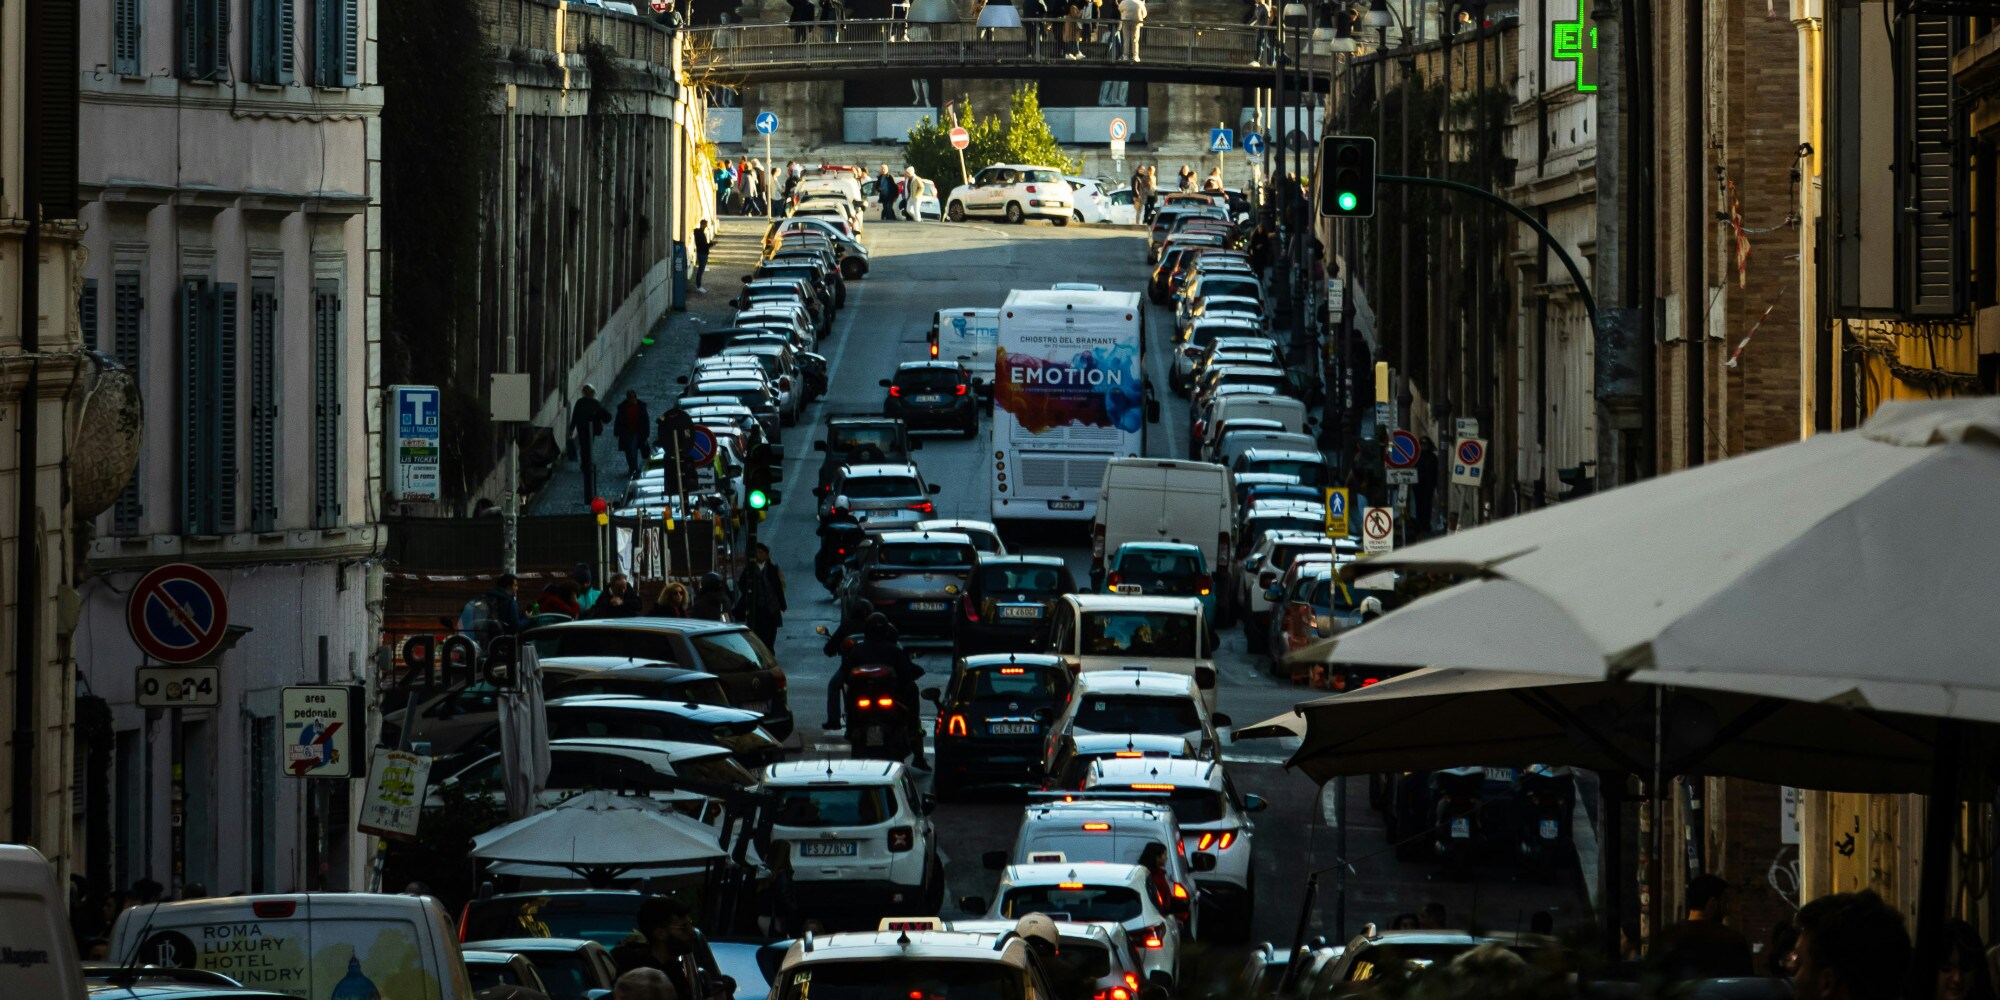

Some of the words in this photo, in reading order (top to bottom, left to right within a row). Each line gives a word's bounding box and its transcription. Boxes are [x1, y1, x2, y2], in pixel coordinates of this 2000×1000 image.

[1020, 335, 1058, 344] CHIOSTRO
[1060, 337, 1074, 345] DEL
[1076, 337, 1118, 345] BRAMANTE
[1011, 366, 1122, 386] EMOTION
[406, 393, 432, 425] T
[144, 677, 159, 696] 0
[182, 677, 213, 696] 24
[305, 694, 327, 704] area
[294, 707, 338, 720] pedonale
[204, 924, 262, 939] ROMA
[889, 921, 933, 932] TAXI
[204, 938, 285, 955] LUXURY
[204, 955, 274, 970] HOTEL
[222, 968, 305, 986] UNDRY
